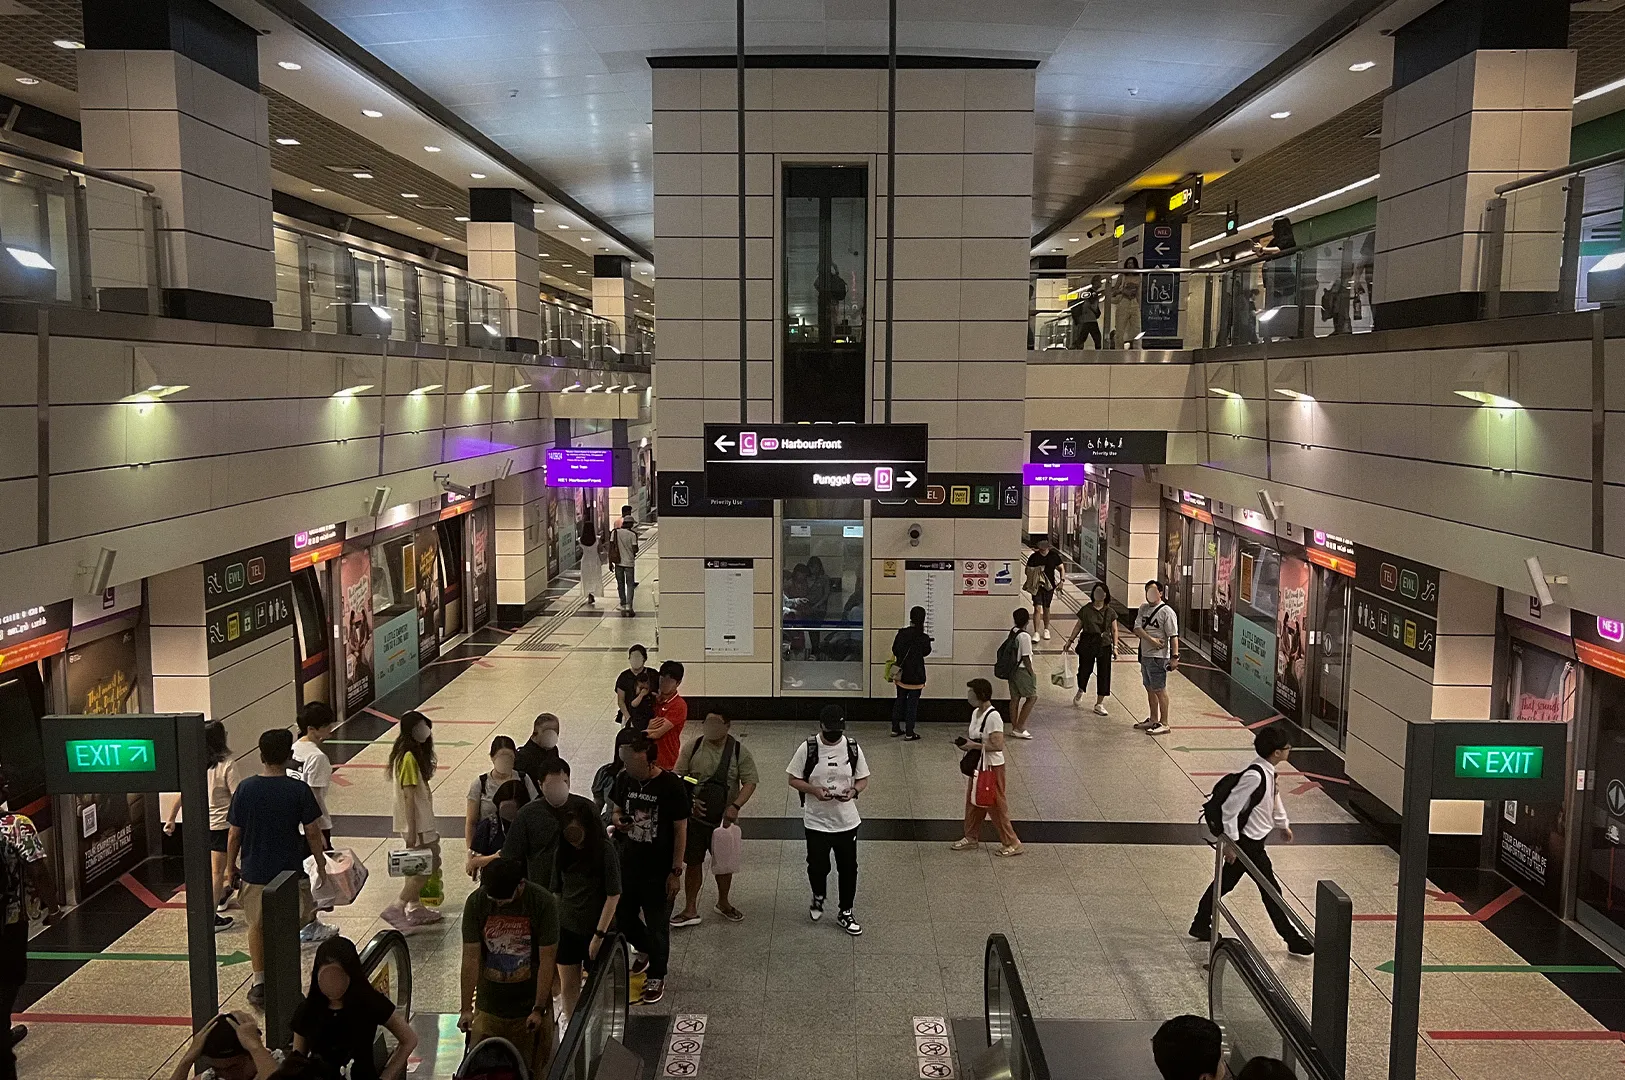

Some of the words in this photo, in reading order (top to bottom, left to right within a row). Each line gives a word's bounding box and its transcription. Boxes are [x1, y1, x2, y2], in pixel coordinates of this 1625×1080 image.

[744, 436, 753, 448] C
[781, 439, 842, 449] HarbourFront
[813, 474, 851, 486] Punggol
[880, 472, 888, 483] D
[927, 490, 938, 500] EL
[228, 571, 242, 584] EWL
[251, 565, 261, 576] TEL
[1384, 570, 1393, 583] TEL
[1403, 577, 1415, 591] EWL
[1602, 620, 1618, 633] NE3
[75, 744, 122, 766] EXIT
[1486, 751, 1534, 773] EXIT
[97, 834, 116, 853] EMPATHY
[117, 828, 126, 840] CAN
[126, 824, 132, 834] BE
[113, 841, 119, 852] TO
[120, 834, 131, 848] THEM
[1502, 831, 1512, 844] YOUR
[1513, 838, 1531, 857] EMPATHY
[1532, 850, 1540, 862] CAN
[1541, 856, 1547, 867] BE
[1502, 840, 1526, 863] COMFORTING
[1527, 857, 1532, 867] TO
[1533, 861, 1546, 876] THEM
